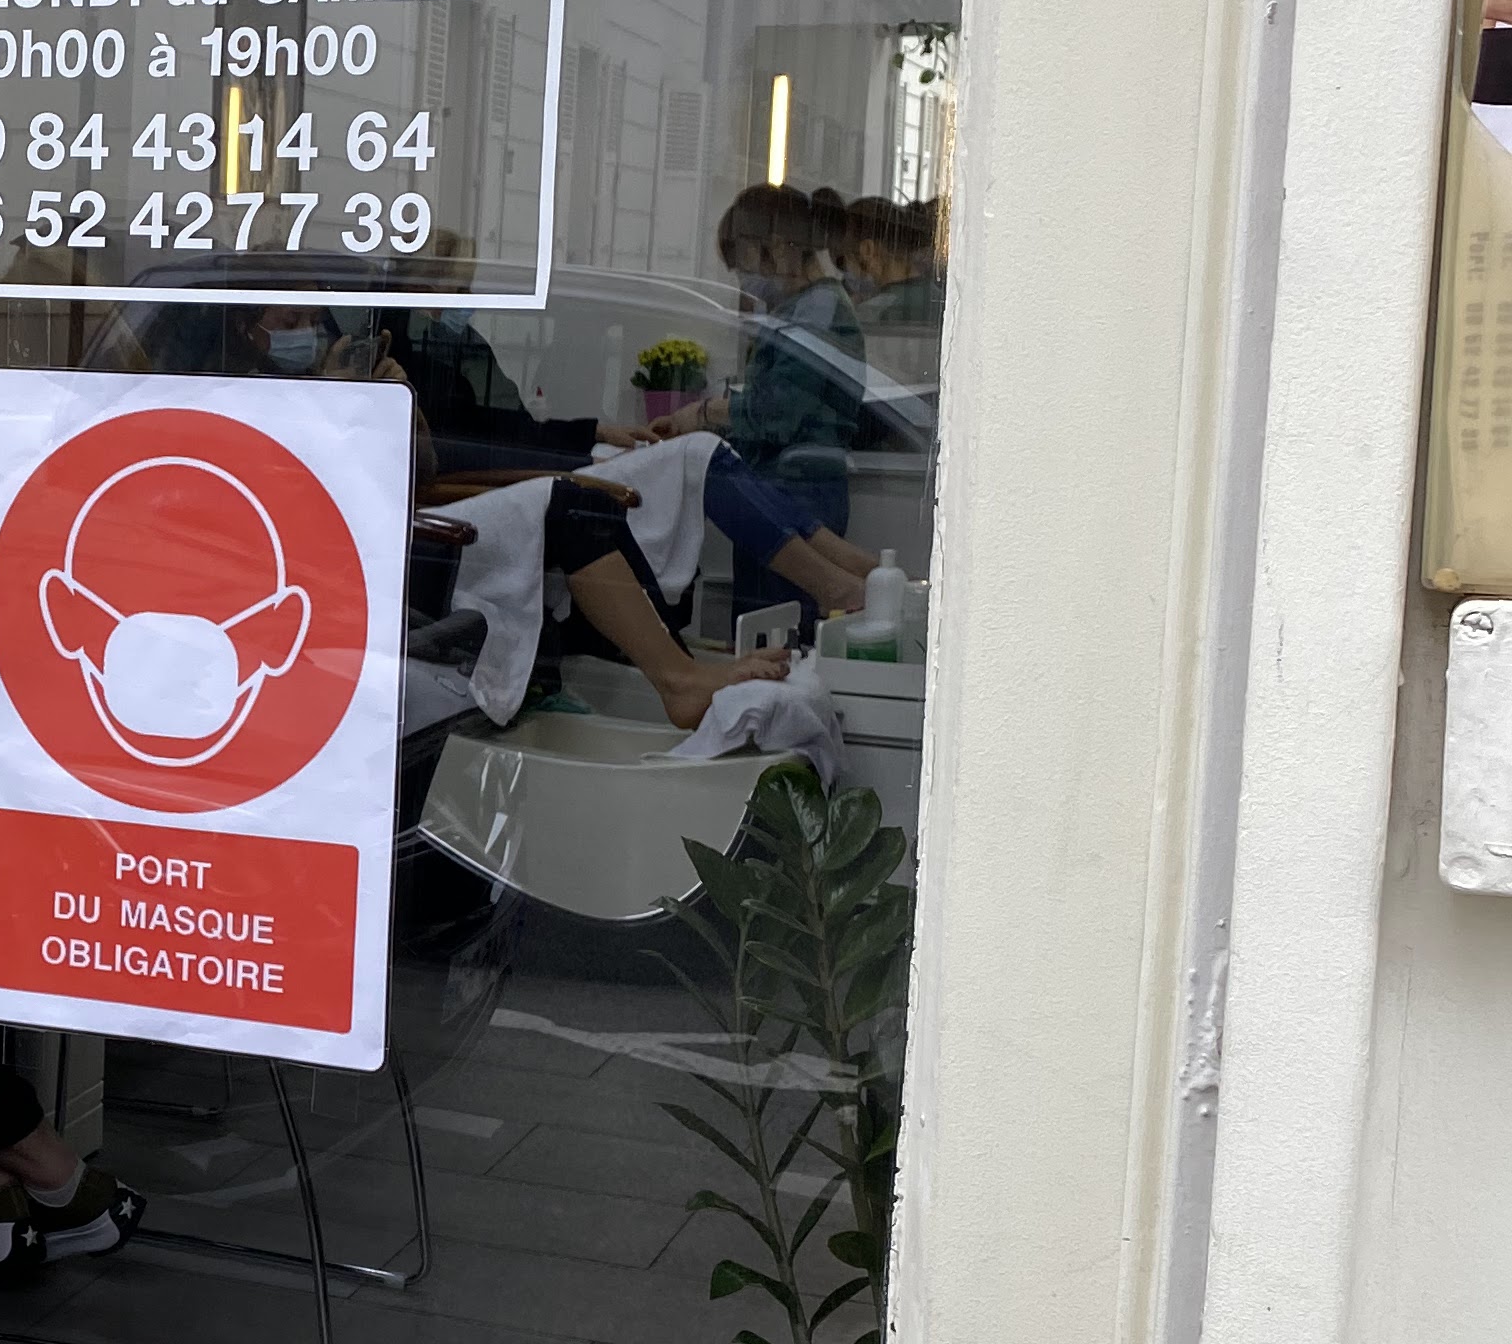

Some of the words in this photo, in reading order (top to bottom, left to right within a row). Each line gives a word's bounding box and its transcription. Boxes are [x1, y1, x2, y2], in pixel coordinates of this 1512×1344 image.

[148, 31, 176, 78] à
[201, 24, 377, 77] 19h00
[26, 112, 109, 171] 84
[131, 112, 217, 171] 43
[239, 113, 319, 170] 14
[346, 110, 436, 171] 64
[24, 191, 106, 248] 52
[129, 191, 214, 250] 42
[226, 193, 319, 251] 77
[341, 192, 431, 253] 39
[116, 852, 212, 889] PORT
[54, 891, 101, 924] DU
[120, 898, 275, 945] MASQUE
[40, 935, 284, 995] OBLIGATOIRE
